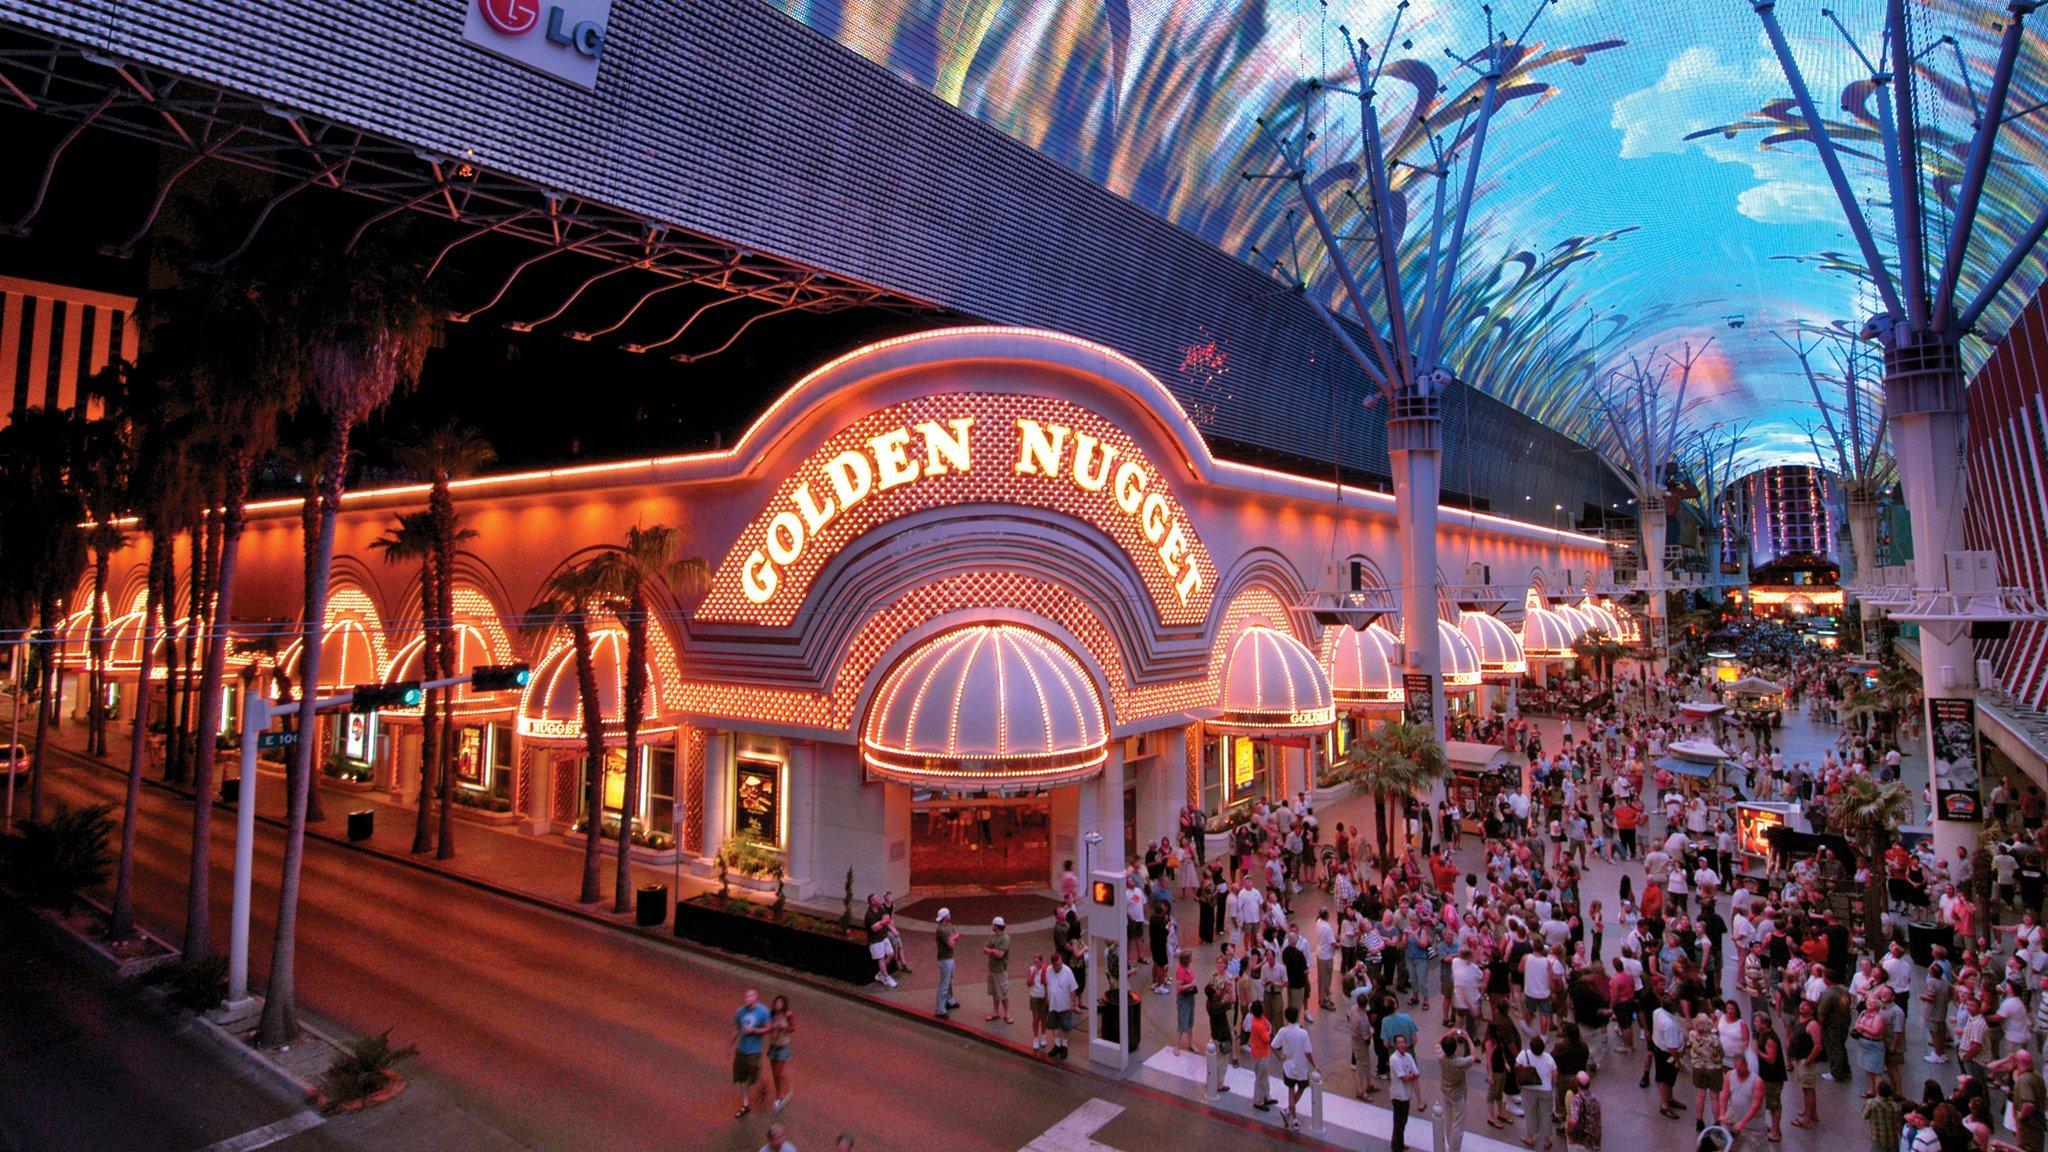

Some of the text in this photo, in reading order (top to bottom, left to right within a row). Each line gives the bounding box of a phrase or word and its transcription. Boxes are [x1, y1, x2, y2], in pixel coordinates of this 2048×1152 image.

[546, 6, 606, 59] LG
[740, 416, 1203, 607] GOLDEN NUGGET
[265, 735, 275, 745] E
